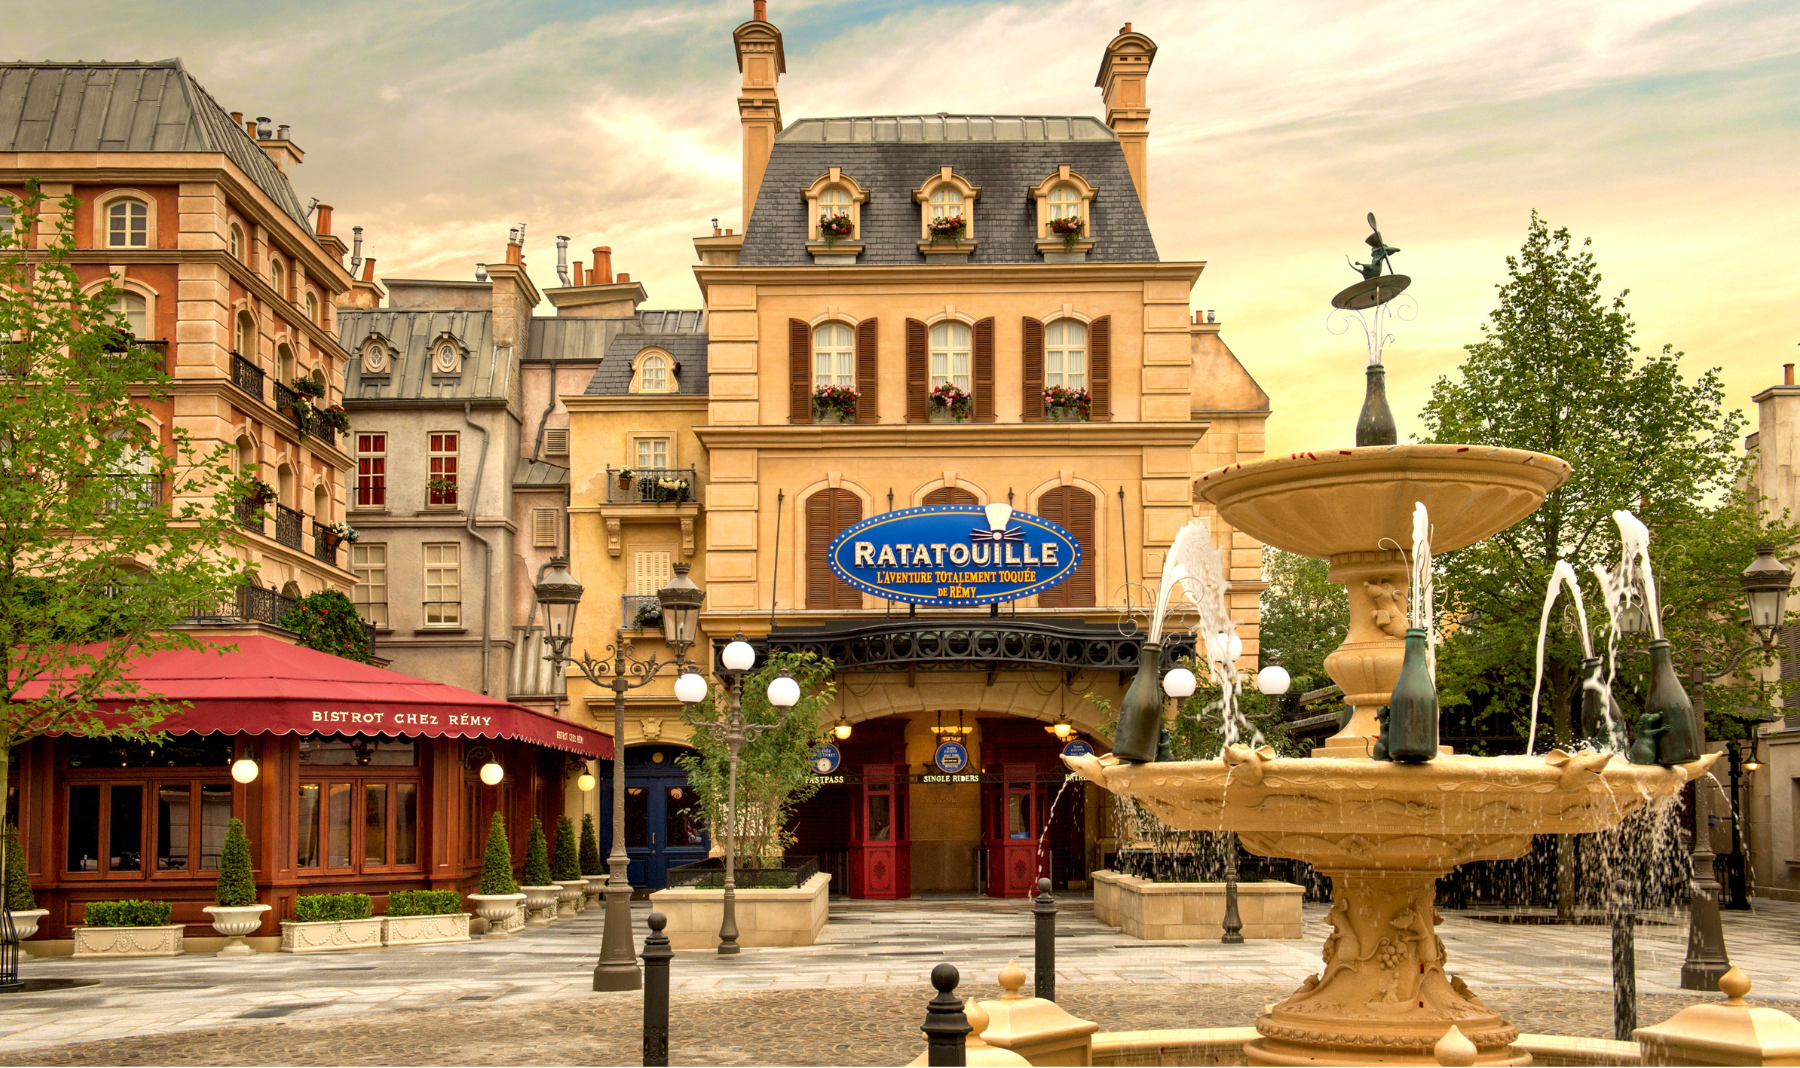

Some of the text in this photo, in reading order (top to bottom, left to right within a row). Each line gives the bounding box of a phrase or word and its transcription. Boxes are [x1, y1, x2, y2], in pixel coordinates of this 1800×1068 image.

[854, 541, 1059, 567] RATATOUILLE
[877, 567, 1036, 584] L'AVENTURE TOTALEMENT TOQUÉE
[938, 583, 977, 598] DE RÉMY
[312, 711, 491, 726] BISTROT CHEZ RÉMY
[804, 775, 844, 784] FASTPASS
[923, 774, 979, 783] SINGLE RIDERS
